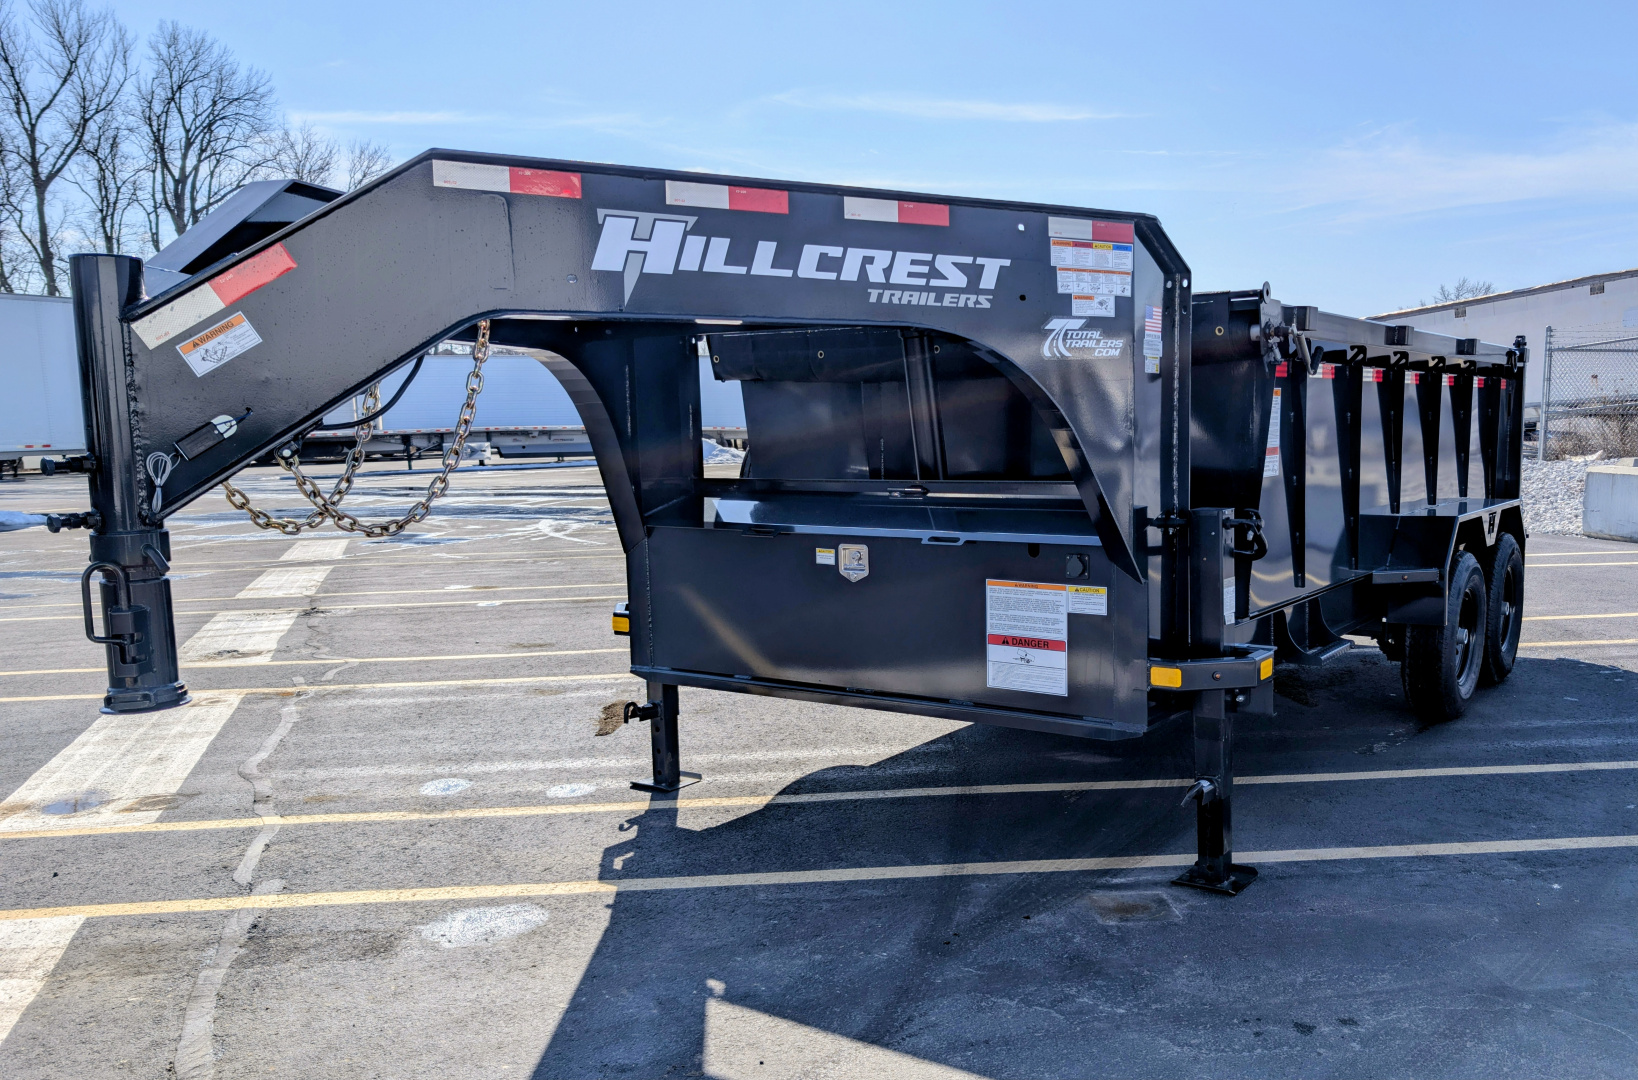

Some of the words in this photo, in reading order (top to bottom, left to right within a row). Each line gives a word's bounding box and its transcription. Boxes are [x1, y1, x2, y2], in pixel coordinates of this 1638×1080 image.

[591, 208, 1011, 290] HILLCREST
[867, 288, 994, 310] TRAILERS
[198, 320, 235, 344] WARNING
[1066, 330, 1104, 340] TOTAL
[1065, 340, 1124, 348] TRAILERS
[1092, 348, 1121, 356] .COM
[1012, 638, 1050, 648] DANGER
